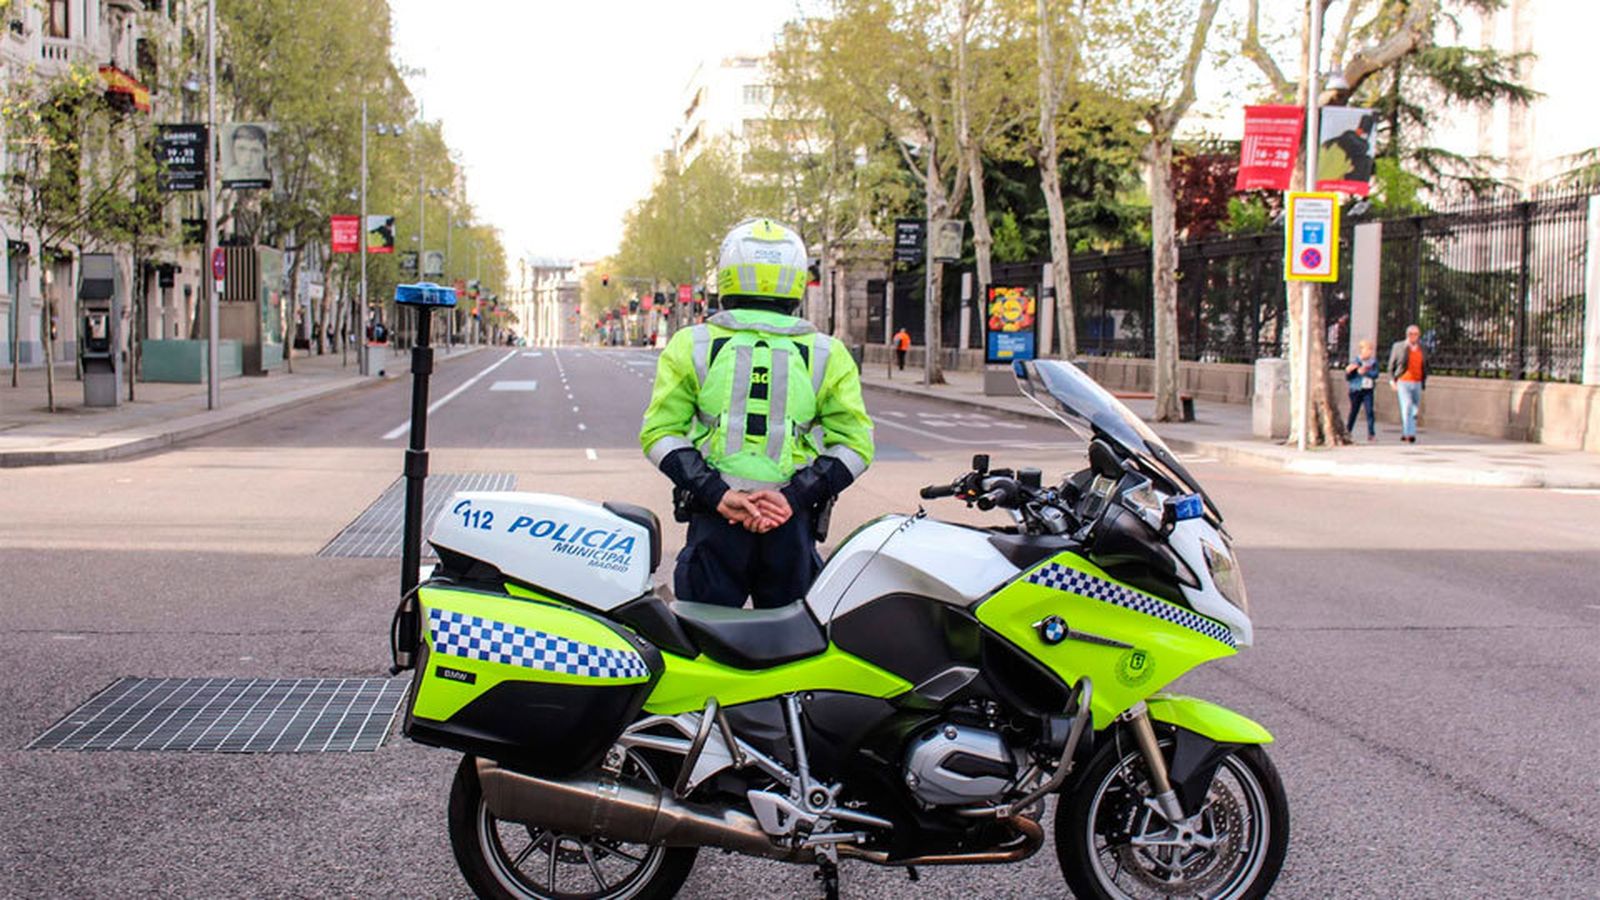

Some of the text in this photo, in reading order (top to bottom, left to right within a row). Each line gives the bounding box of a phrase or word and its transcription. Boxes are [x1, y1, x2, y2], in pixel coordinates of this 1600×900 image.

[463, 509, 636, 554] 112 POLICÍA
[552, 542, 632, 566] MUNICIPAL
[587, 559, 629, 574] MADRID
